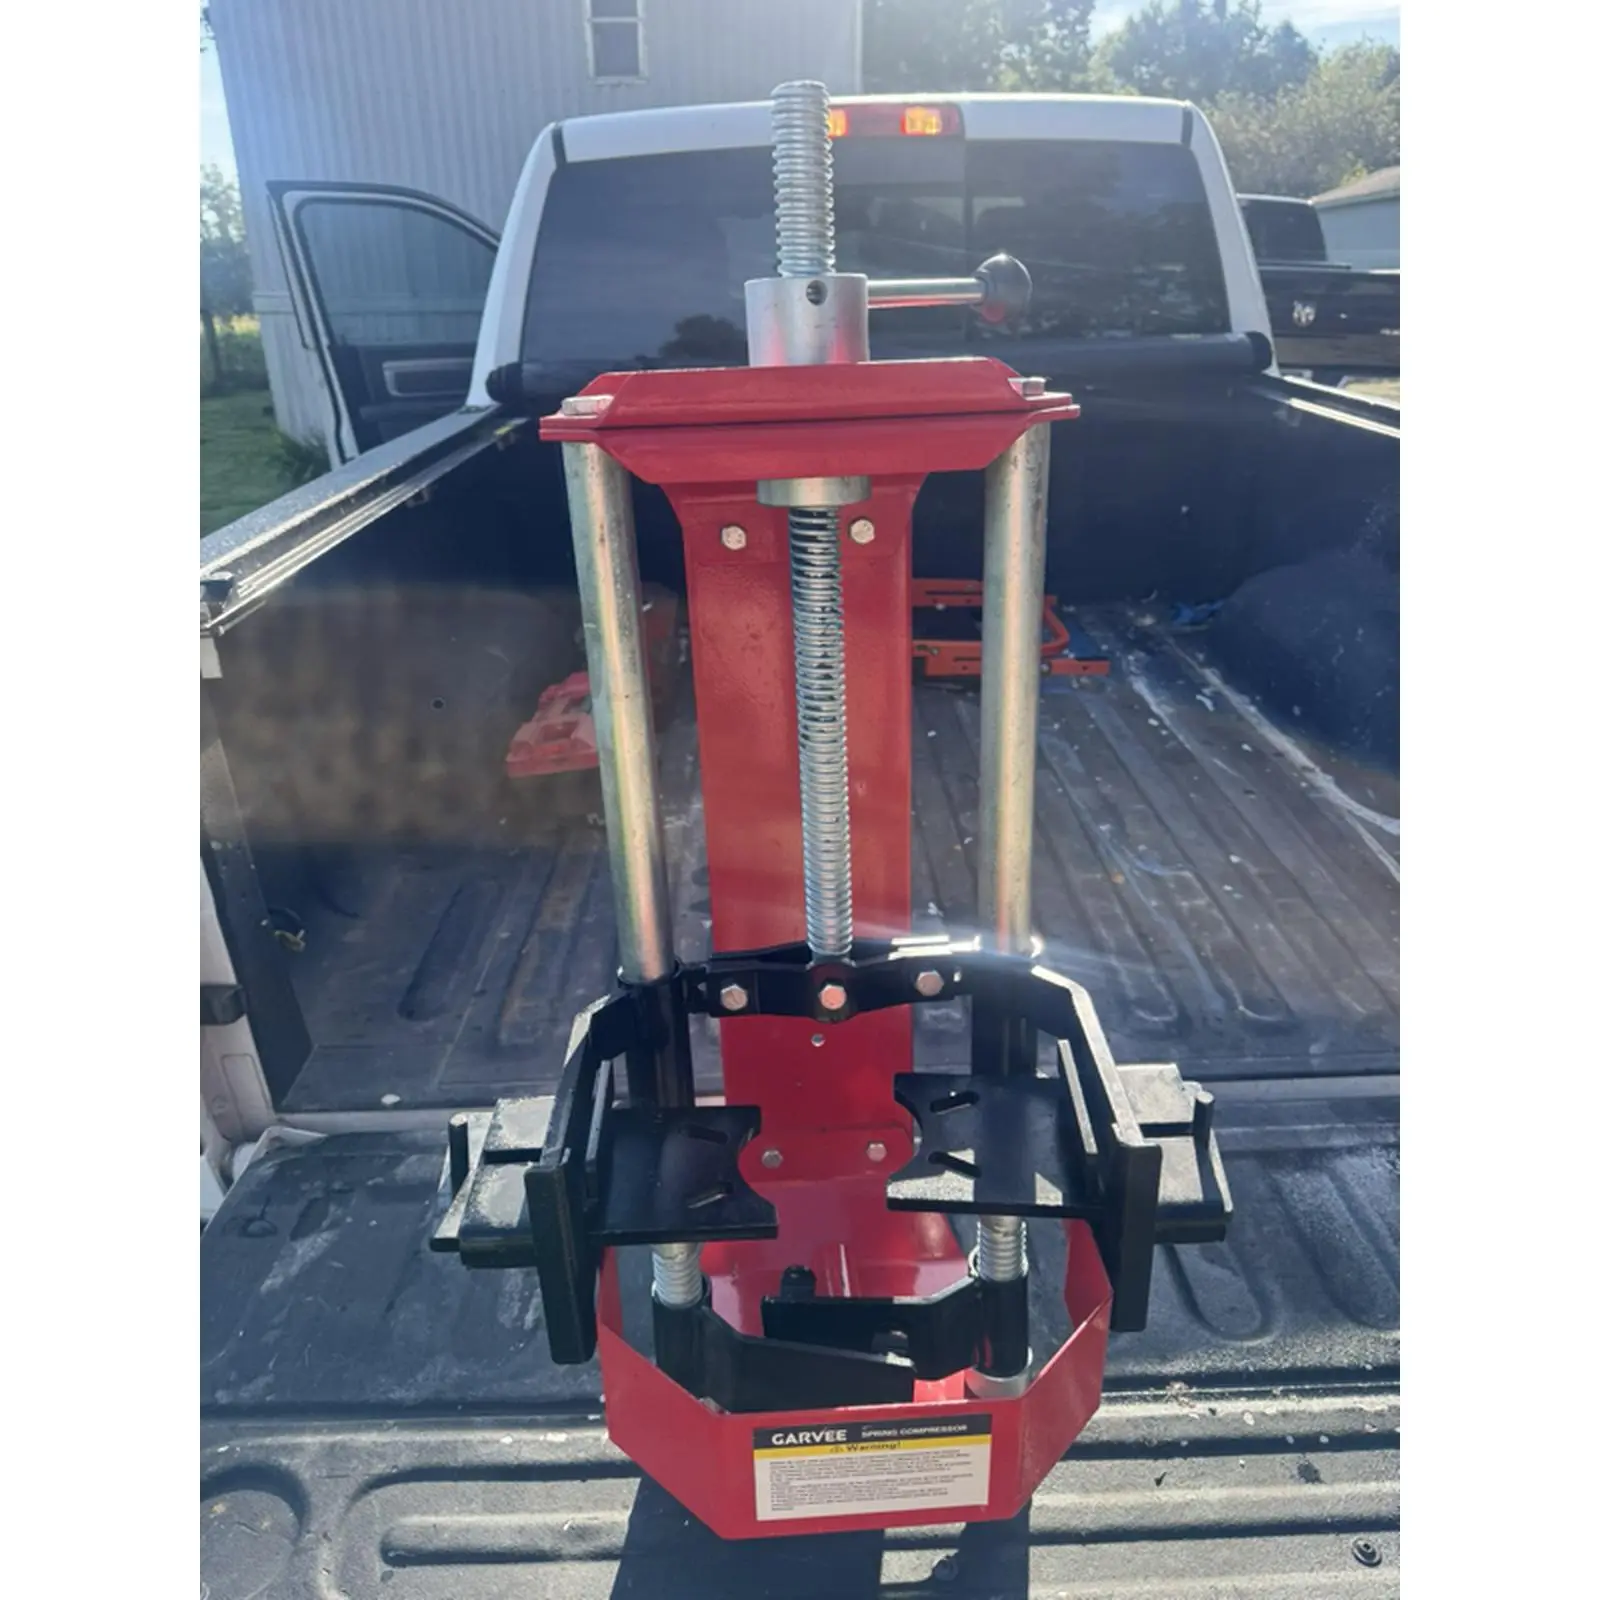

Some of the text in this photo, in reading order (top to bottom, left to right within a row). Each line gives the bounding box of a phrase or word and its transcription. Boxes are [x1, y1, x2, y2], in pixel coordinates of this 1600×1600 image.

[771, 1428, 848, 1446] GARVEE
[861, 1424, 968, 1439] SPRING COMPRESSOR
[846, 1441, 902, 1452] Warning!
